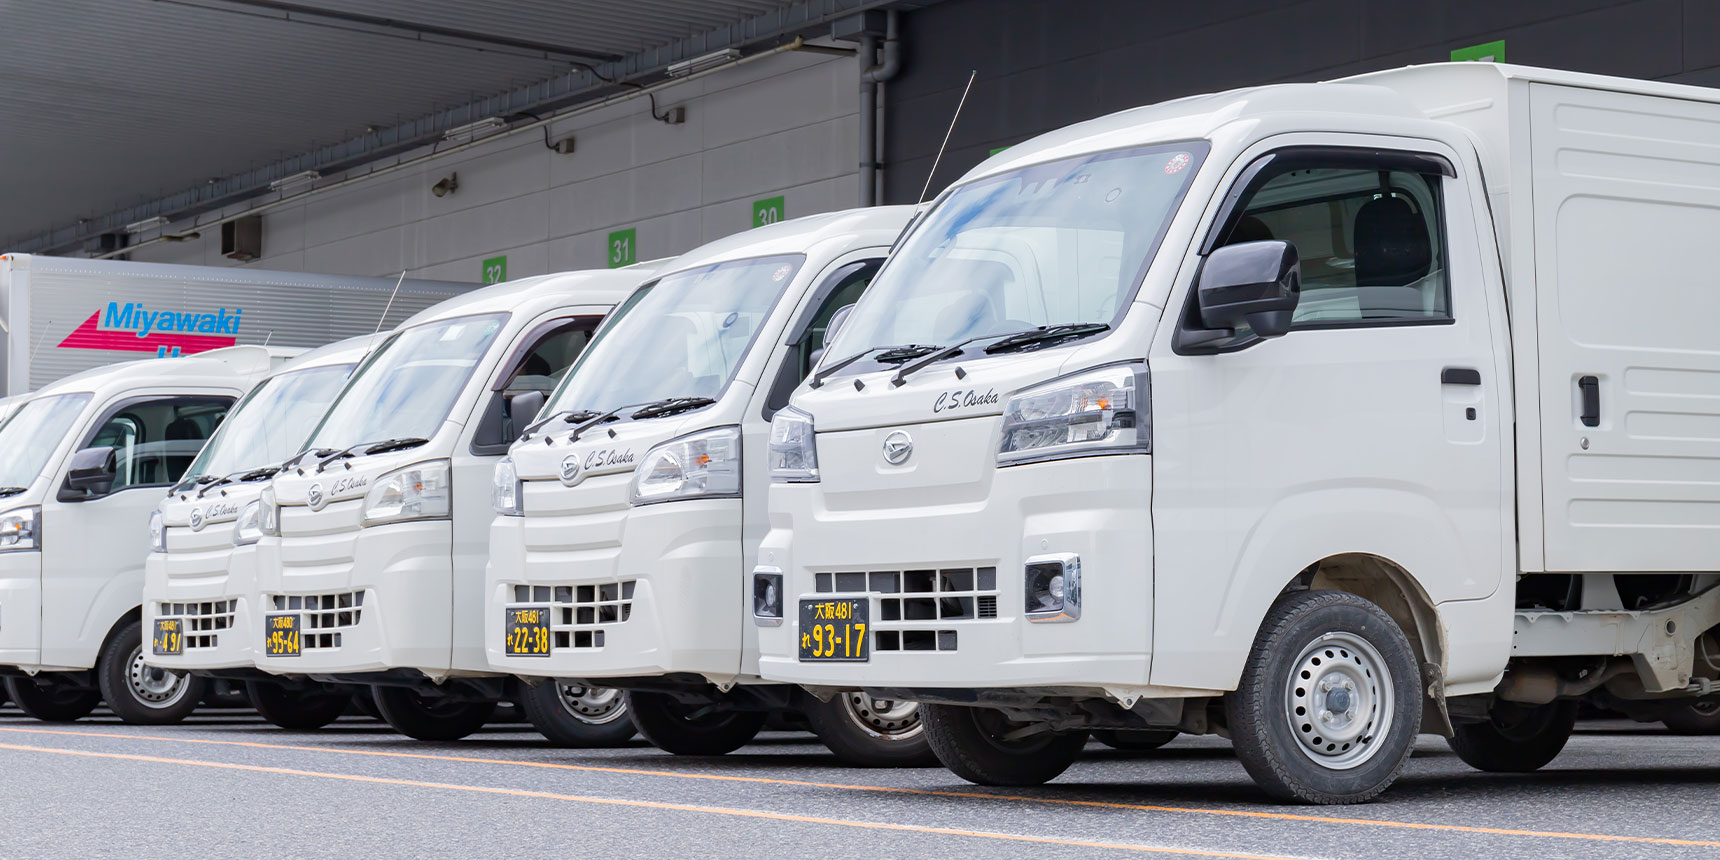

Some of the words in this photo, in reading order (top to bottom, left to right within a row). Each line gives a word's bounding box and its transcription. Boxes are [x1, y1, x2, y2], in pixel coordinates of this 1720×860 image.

[759, 207, 777, 225] 30
[613, 237, 629, 264] 31
[487, 264, 501, 284] 32
[104, 301, 242, 337] Miyawaki
[272, 631, 299, 653] 95-64
[514, 627, 548, 653] 22-38
[813, 624, 866, 657] 93-17
